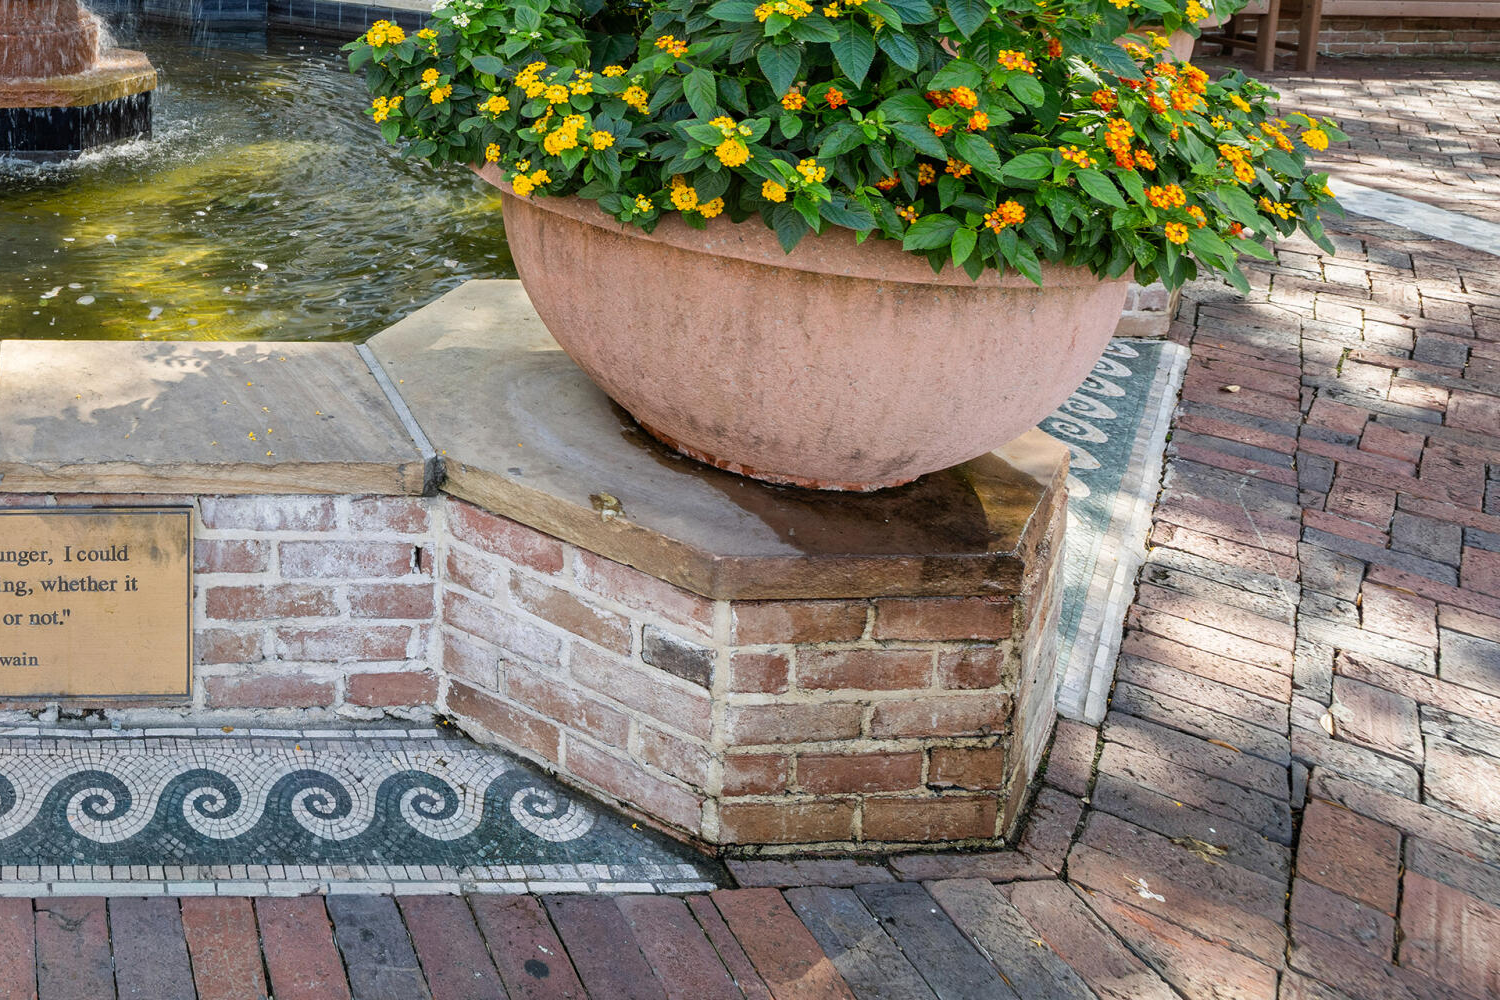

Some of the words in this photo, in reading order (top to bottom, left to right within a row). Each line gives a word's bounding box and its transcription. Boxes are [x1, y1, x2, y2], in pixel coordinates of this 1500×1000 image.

[63, 545, 73, 562] I
[76, 544, 130, 562] could
[40, 575, 118, 593] whether
[124, 574, 139, 592] it
[2, 613, 23, 626] or
[29, 608, 71, 626] not."
